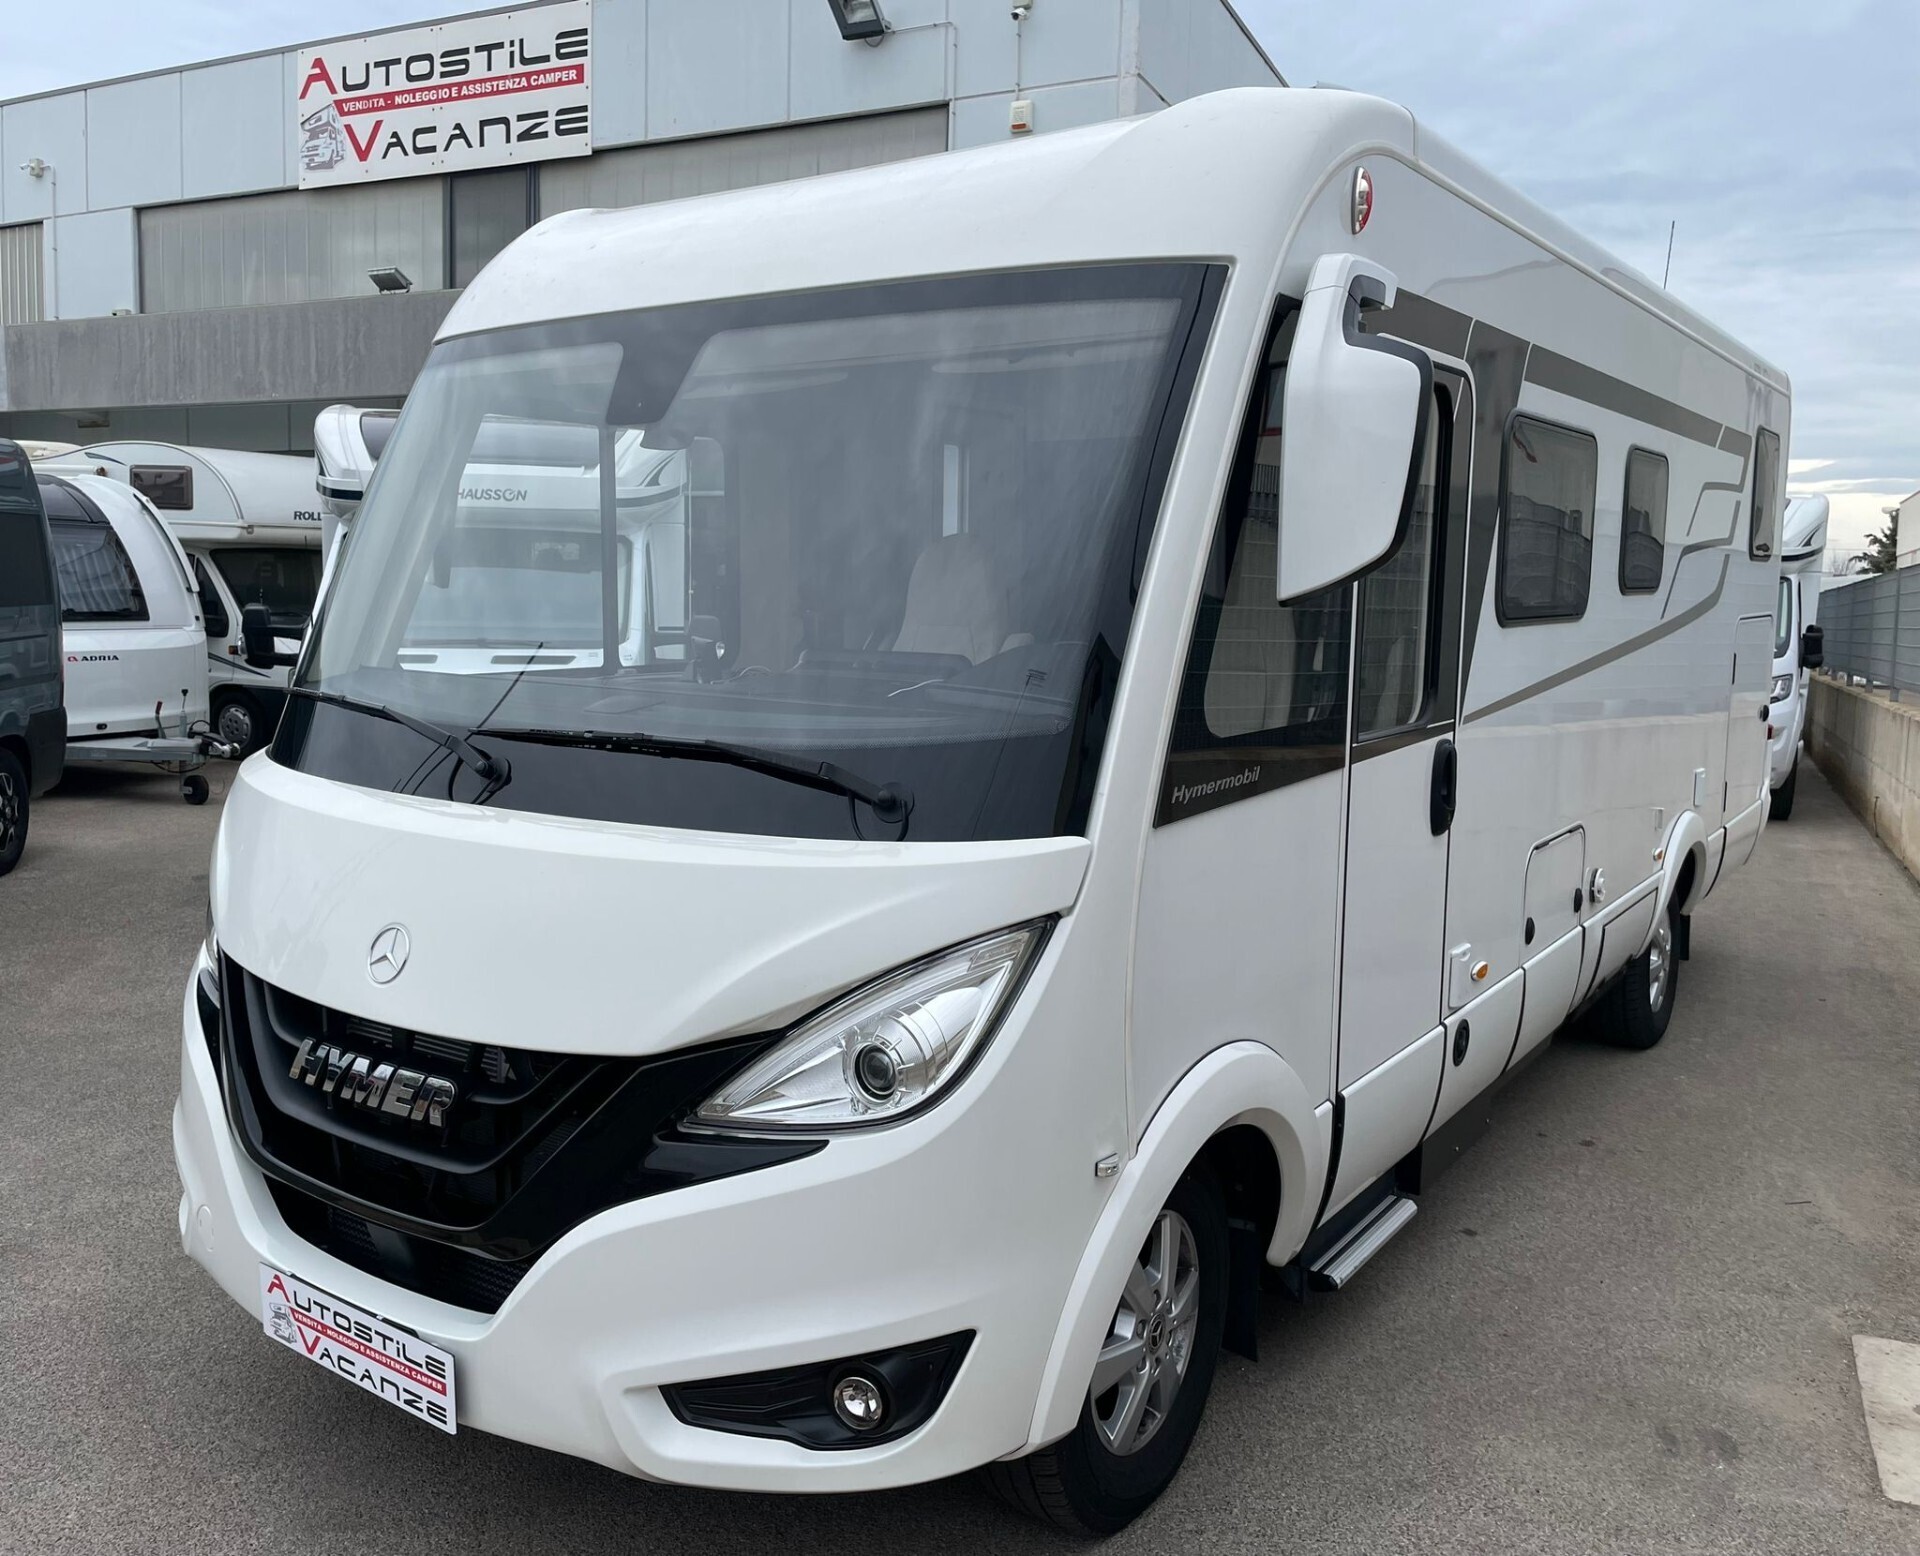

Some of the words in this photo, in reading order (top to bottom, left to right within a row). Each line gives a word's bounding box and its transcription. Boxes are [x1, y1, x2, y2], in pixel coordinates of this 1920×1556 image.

[342, 98, 385, 112] VENDITA
[394, 90, 450, 105] NOLEGGIO
[451, 88, 458, 97] E
[460, 77, 528, 96] ASSISTENZA
[530, 69, 578, 85] CAMPER
[294, 510, 322, 521] ROLL
[1170, 765, 1261, 805] Hymermobil
[288, 1037, 458, 1128] HYMER
[293, 1311, 322, 1334] VENDITA
[326, 1325, 360, 1351] NOLEGGIO
[360, 1345, 366, 1353] E
[365, 1348, 411, 1376] ASSISTENZA
[411, 1370, 443, 1392] CAMPER
